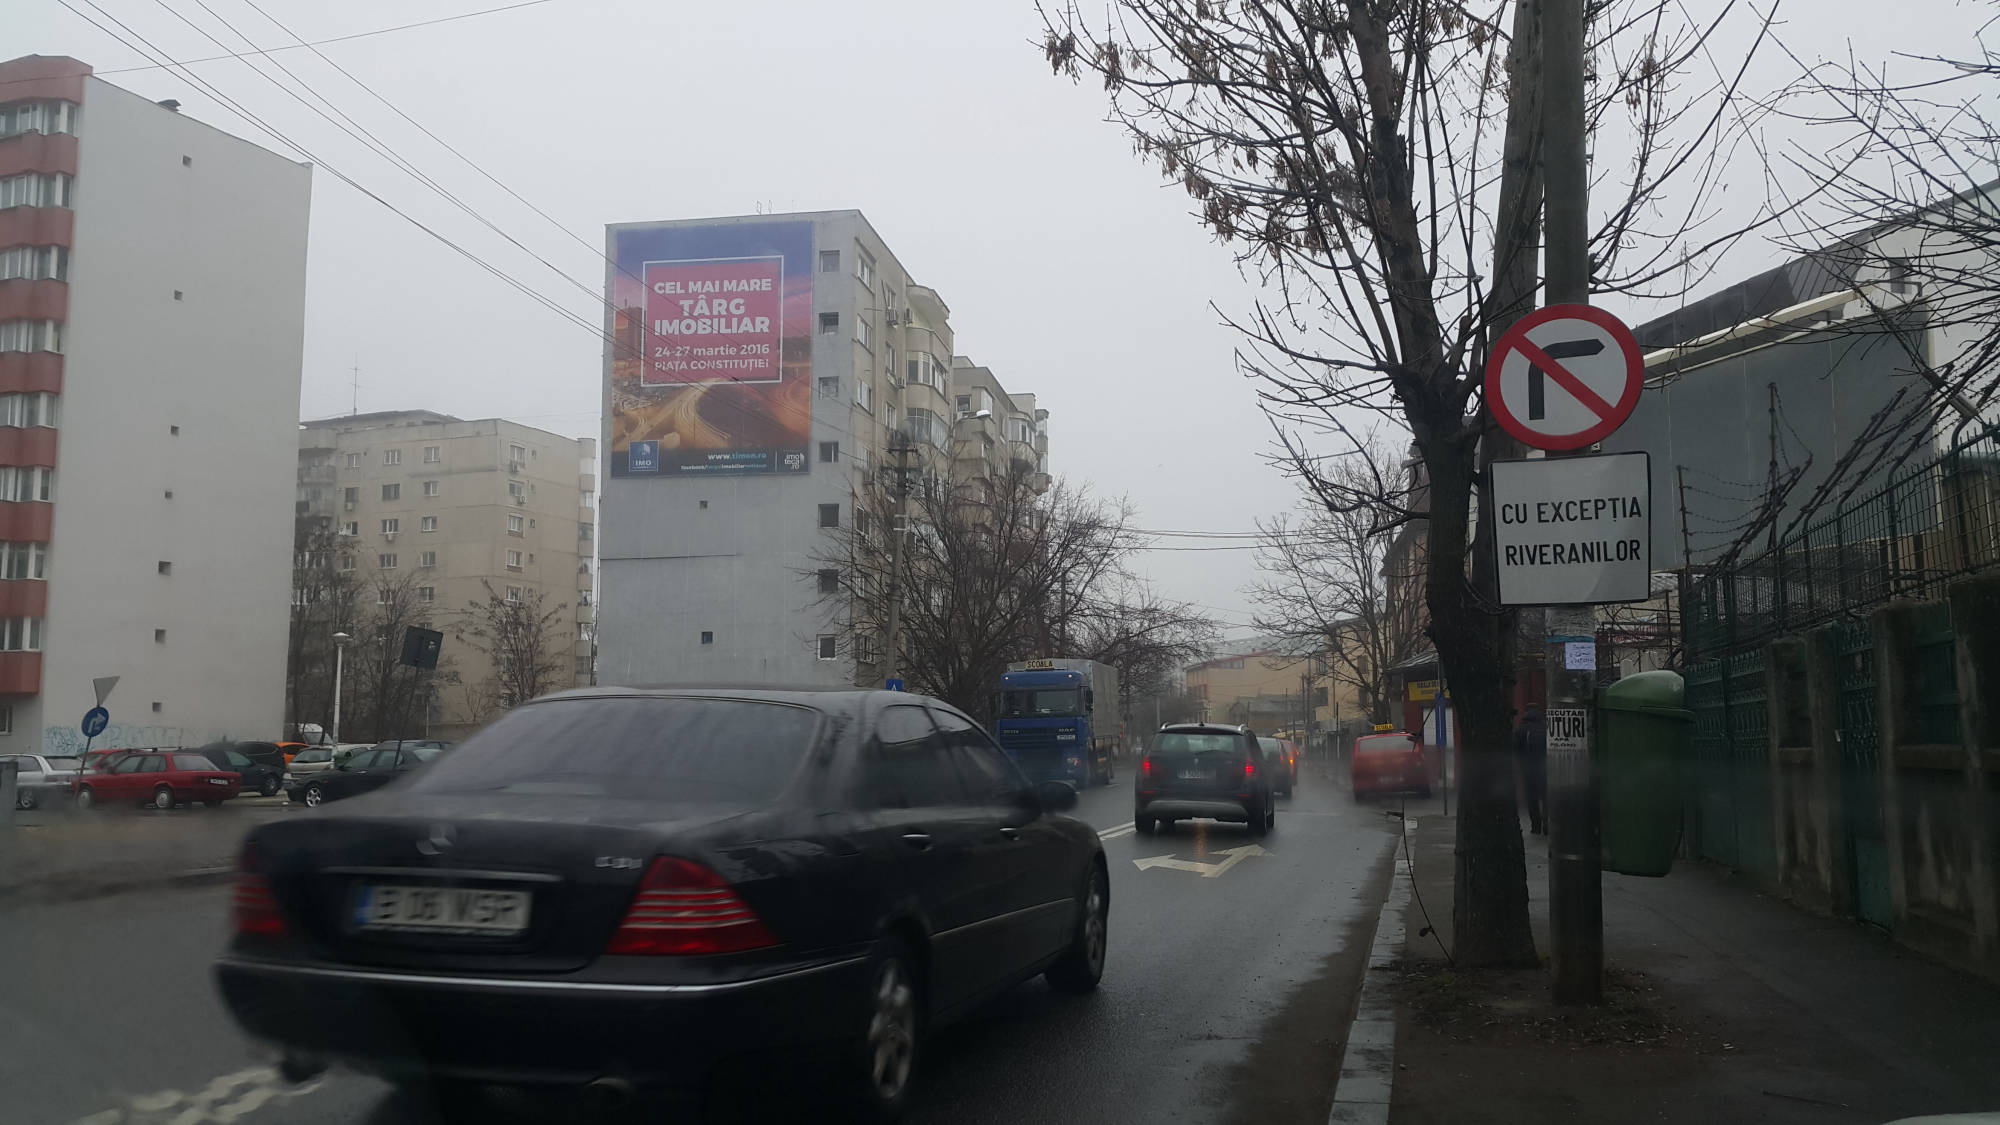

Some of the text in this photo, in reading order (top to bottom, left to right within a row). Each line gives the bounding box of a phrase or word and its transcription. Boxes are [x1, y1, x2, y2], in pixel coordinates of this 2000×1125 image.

[654, 278, 772, 294] CEL MAI MARE
[679, 294, 745, 316] TÂRG
[654, 316, 770, 336] IMOBILIAR
[655, 343, 770, 357] 24-27 martie 2016
[1502, 496, 1642, 525] CU EXCEPȚIA
[1505, 539, 1641, 566] RIVERANILOR
